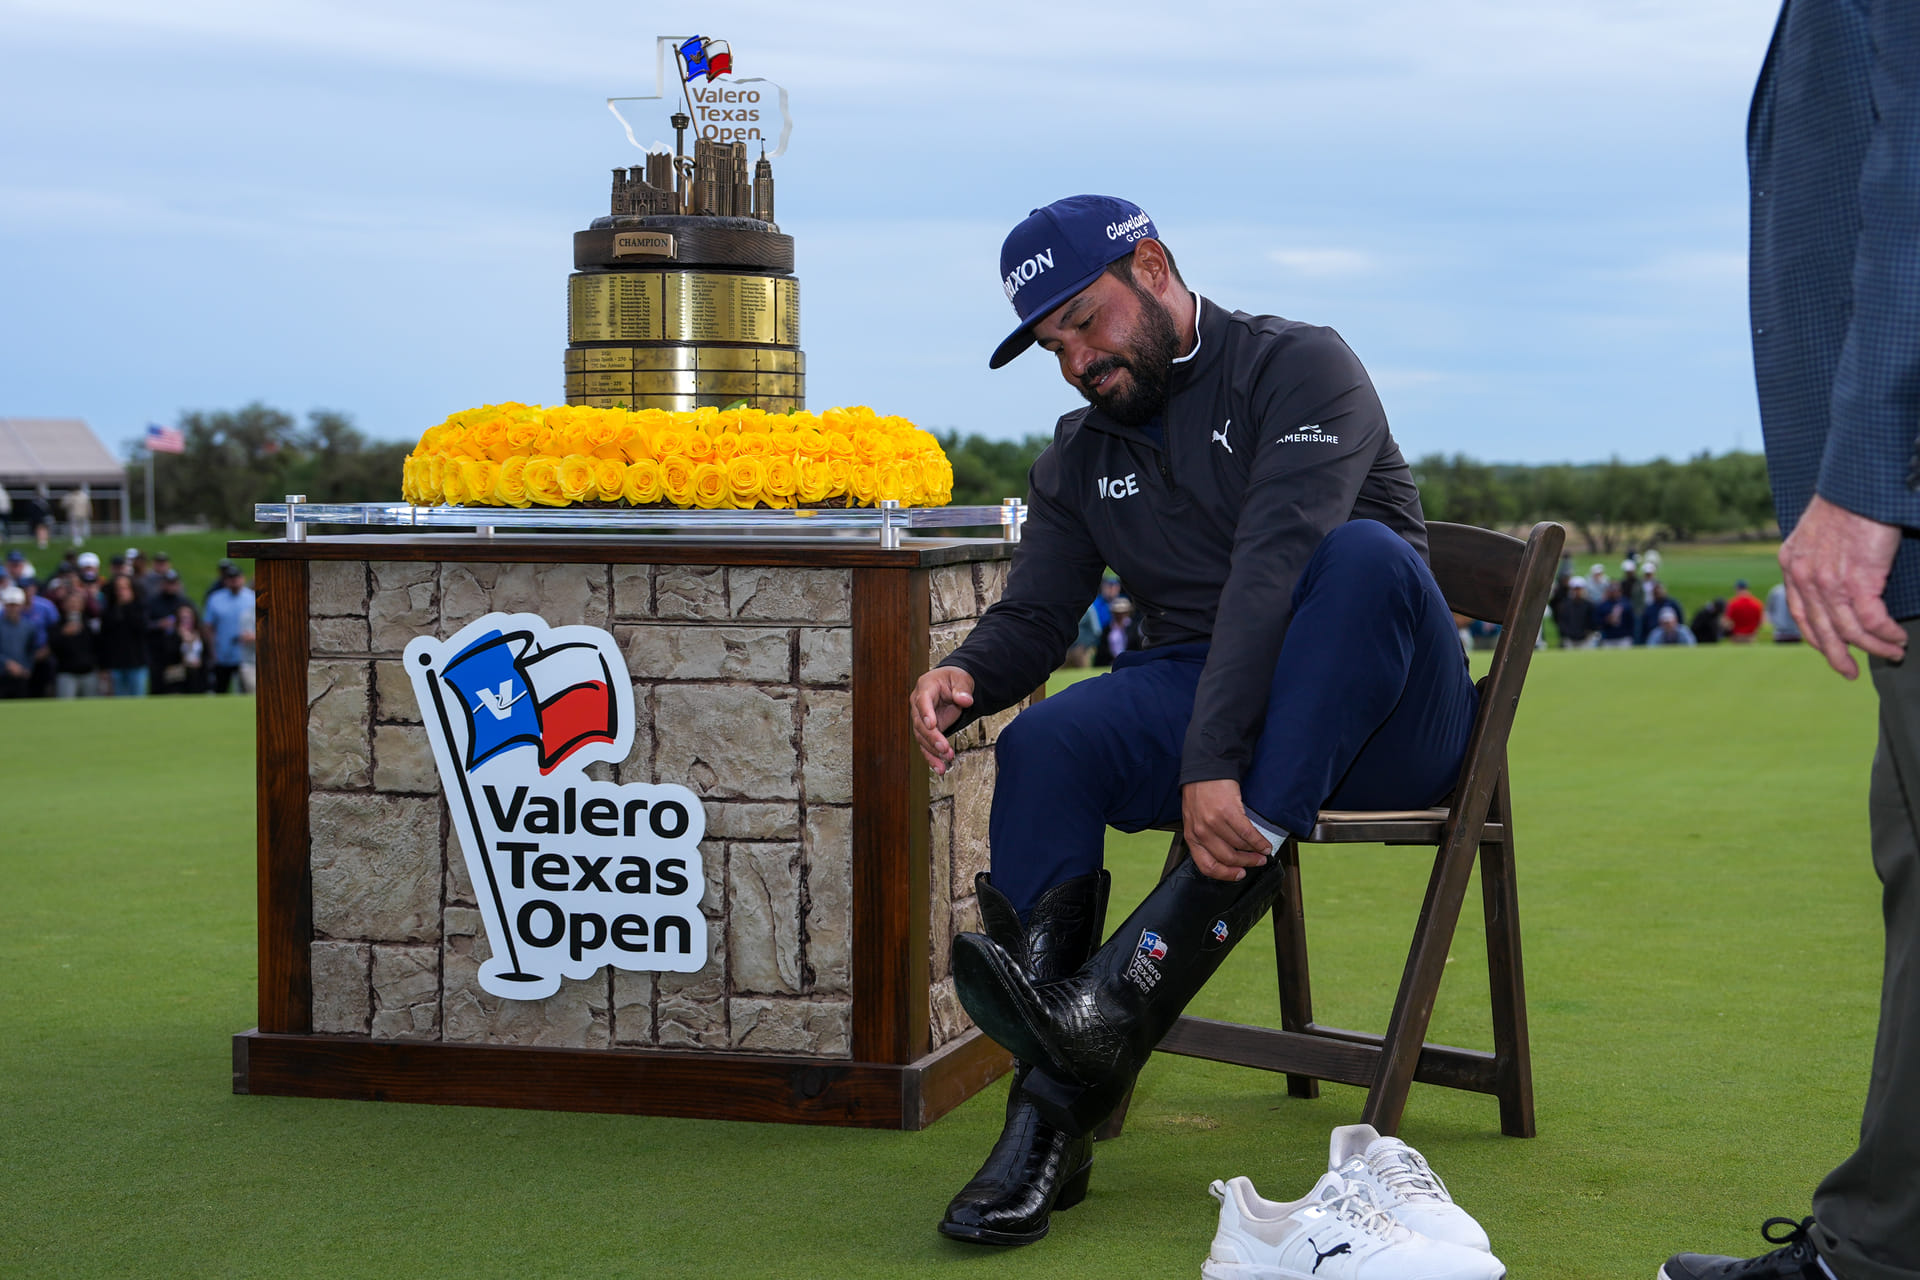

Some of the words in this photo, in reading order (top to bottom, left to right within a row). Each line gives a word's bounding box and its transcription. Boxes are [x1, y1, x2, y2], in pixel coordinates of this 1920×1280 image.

[692, 87, 760, 103] Valero
[696, 106, 759, 121] Texas
[703, 124, 760, 142] Open
[1106, 210, 1149, 240] Cleveland
[1126, 226, 1149, 242] GOLF
[618, 238, 668, 247] CHAMPION
[1004, 248, 1054, 301] RIXON
[482, 785, 689, 839] Valero
[496, 842, 689, 896] Texas
[516, 899, 692, 962] Open
[1133, 958, 1156, 987] Texas
[1137, 950, 1161, 981] Valero
[1129, 968, 1150, 994] Open
